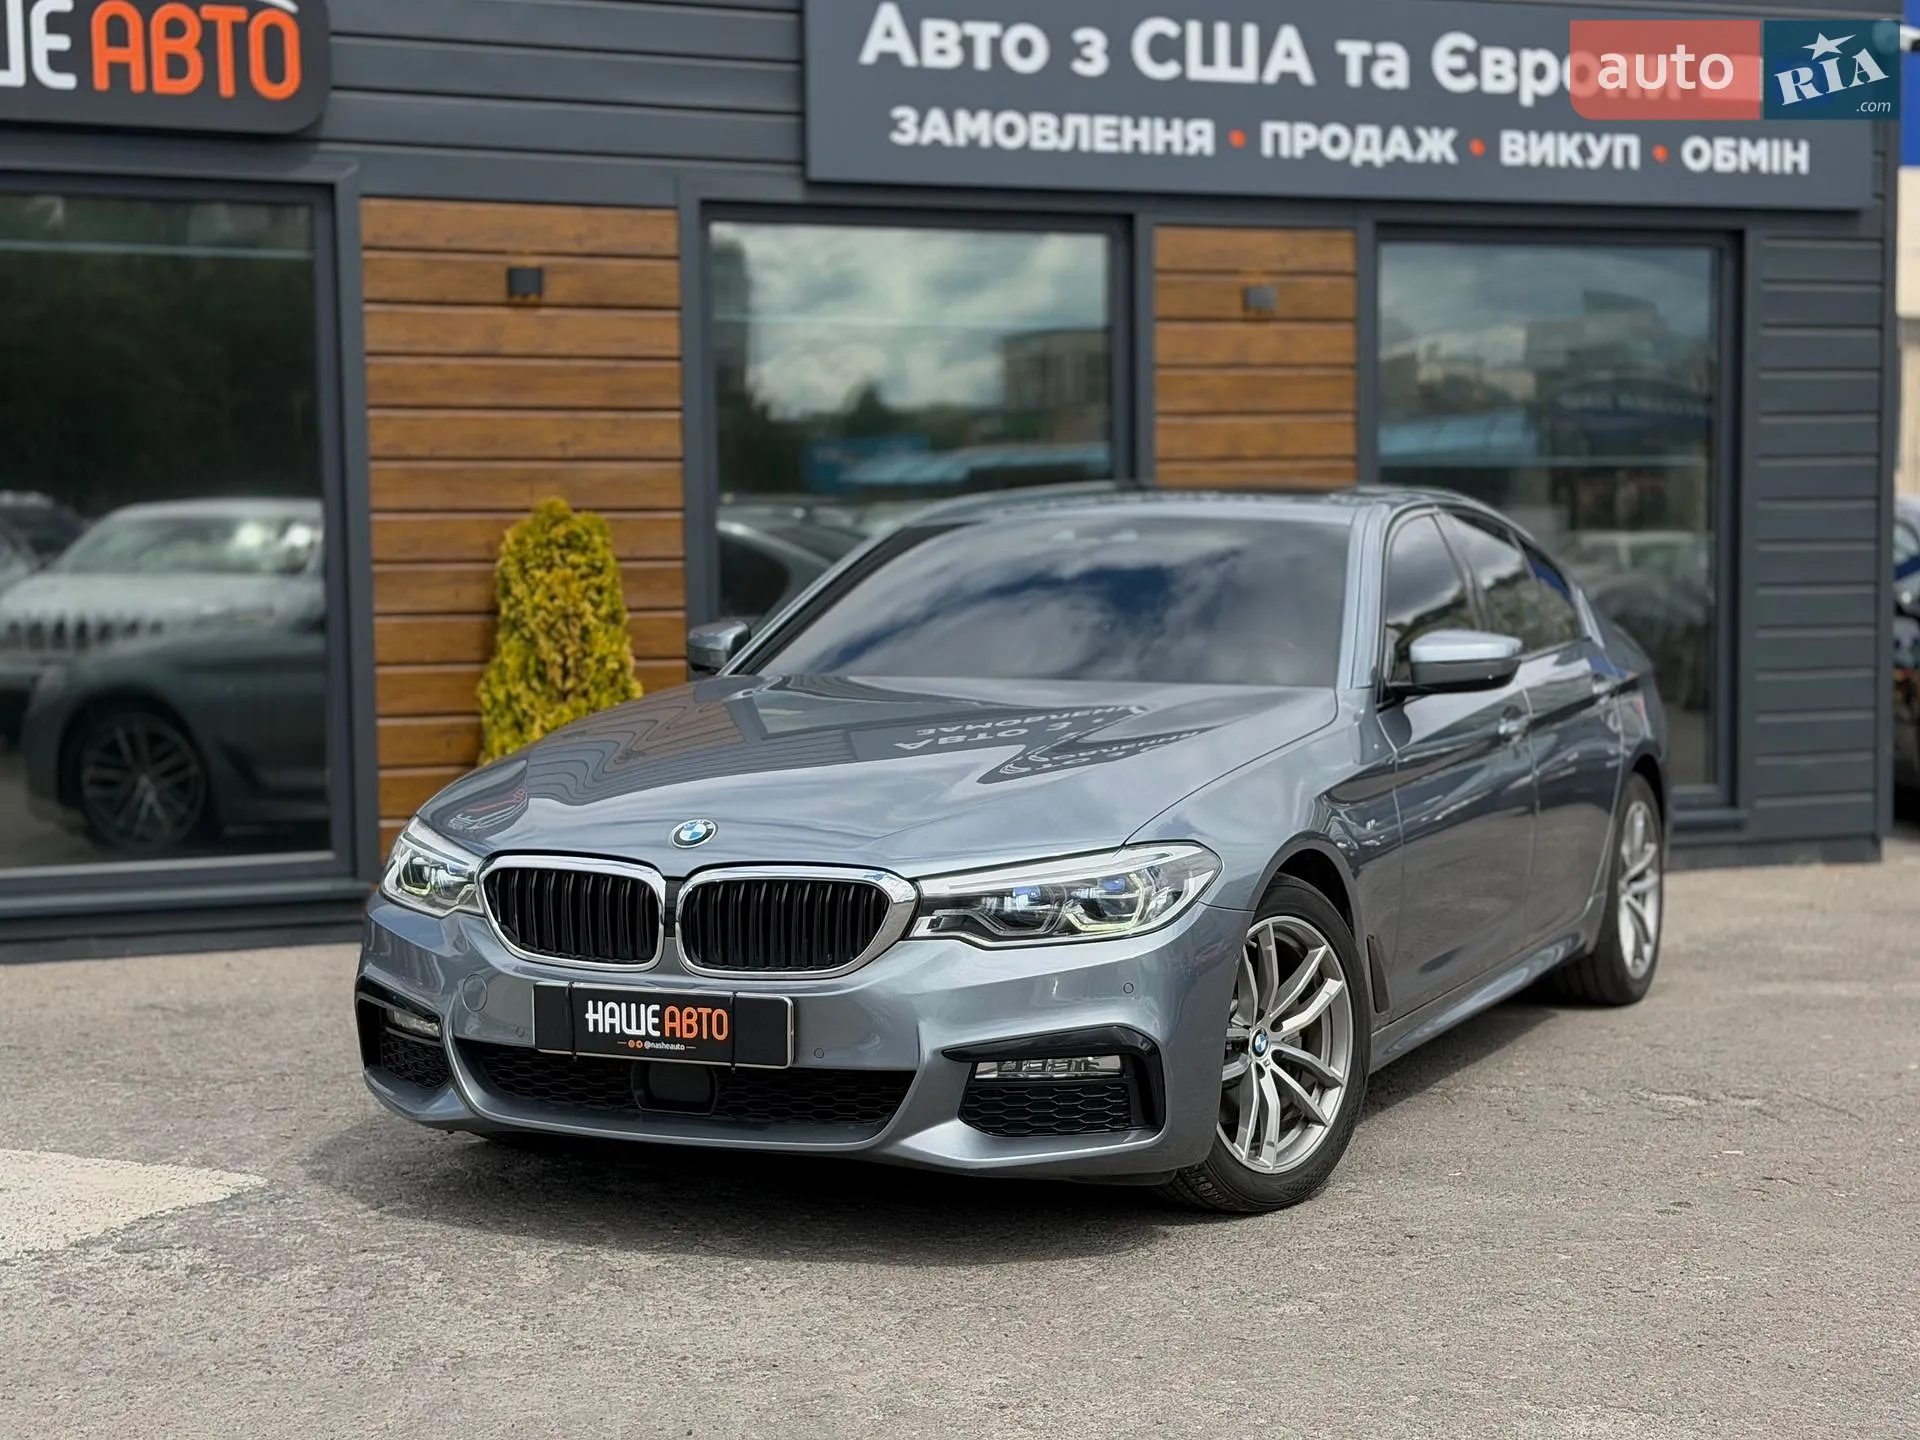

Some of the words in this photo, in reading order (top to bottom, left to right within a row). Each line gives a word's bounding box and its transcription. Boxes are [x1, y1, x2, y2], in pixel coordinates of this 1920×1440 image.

[91, 0, 302, 101] АВТО
[1131, 16, 1316, 86] США
[1335, 38, 1410, 91] та
[889, 105, 1216, 156] ЗАМОВЛЕННЯ
[1261, 121, 1458, 167] ПРОДАЖ
[1500, 130, 1641, 170] ВИКУП
[1681, 136, 1810, 175] ОБМІН
[585, 1000, 661, 1037] НАШЕ
[664, 1005, 729, 1041] АВТО
